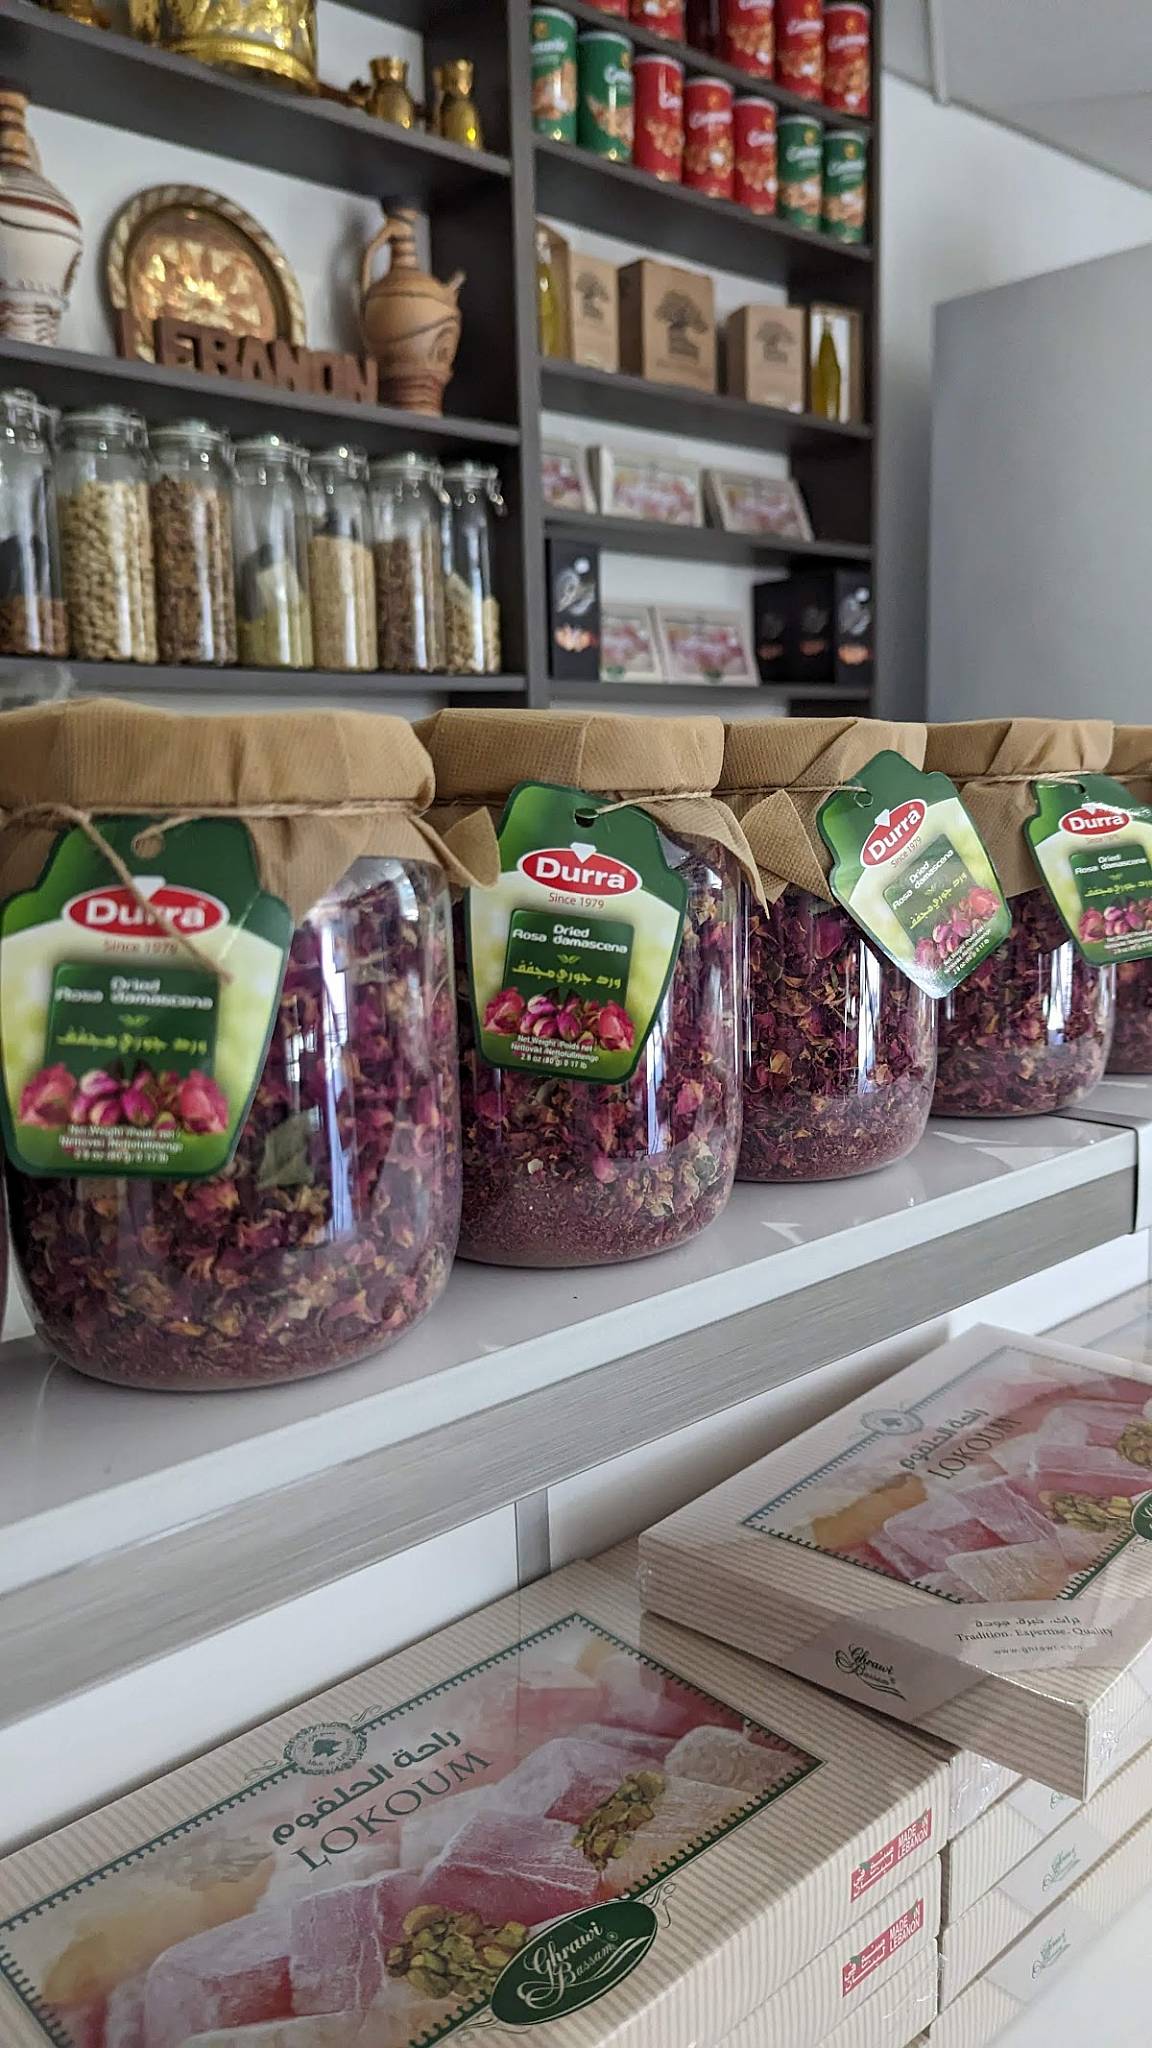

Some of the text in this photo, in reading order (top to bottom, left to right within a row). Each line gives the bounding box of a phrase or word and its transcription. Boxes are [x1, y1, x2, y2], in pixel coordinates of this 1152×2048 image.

[867, 808, 922, 861] Durra
[1068, 815, 1125, 831] Durra
[535, 857, 626, 890] Durra
[909, 861, 929, 883] Dried
[549, 893, 605, 909] Since 1979
[892, 889, 913, 910] Rosa
[512, 928, 628, 954] Rosa damascena
[553, 924, 590, 938] Dried
[596, 975, 622, 989] ورد
[928, 1416, 1022, 1480] LOKOUM
[392, 1731, 461, 1768] راحة
[272, 1764, 394, 1846] الحلقوم
[291, 1751, 494, 1872] LOKOUM
[897, 1828, 928, 1860] LEBANON
[898, 1823, 917, 1847] MADE
[889, 1915, 908, 1939] MADE
[890, 1920, 920, 1952] LEBANON
[524, 1921, 604, 1977] Ghrawi
[554, 1944, 618, 1986] Bassam
